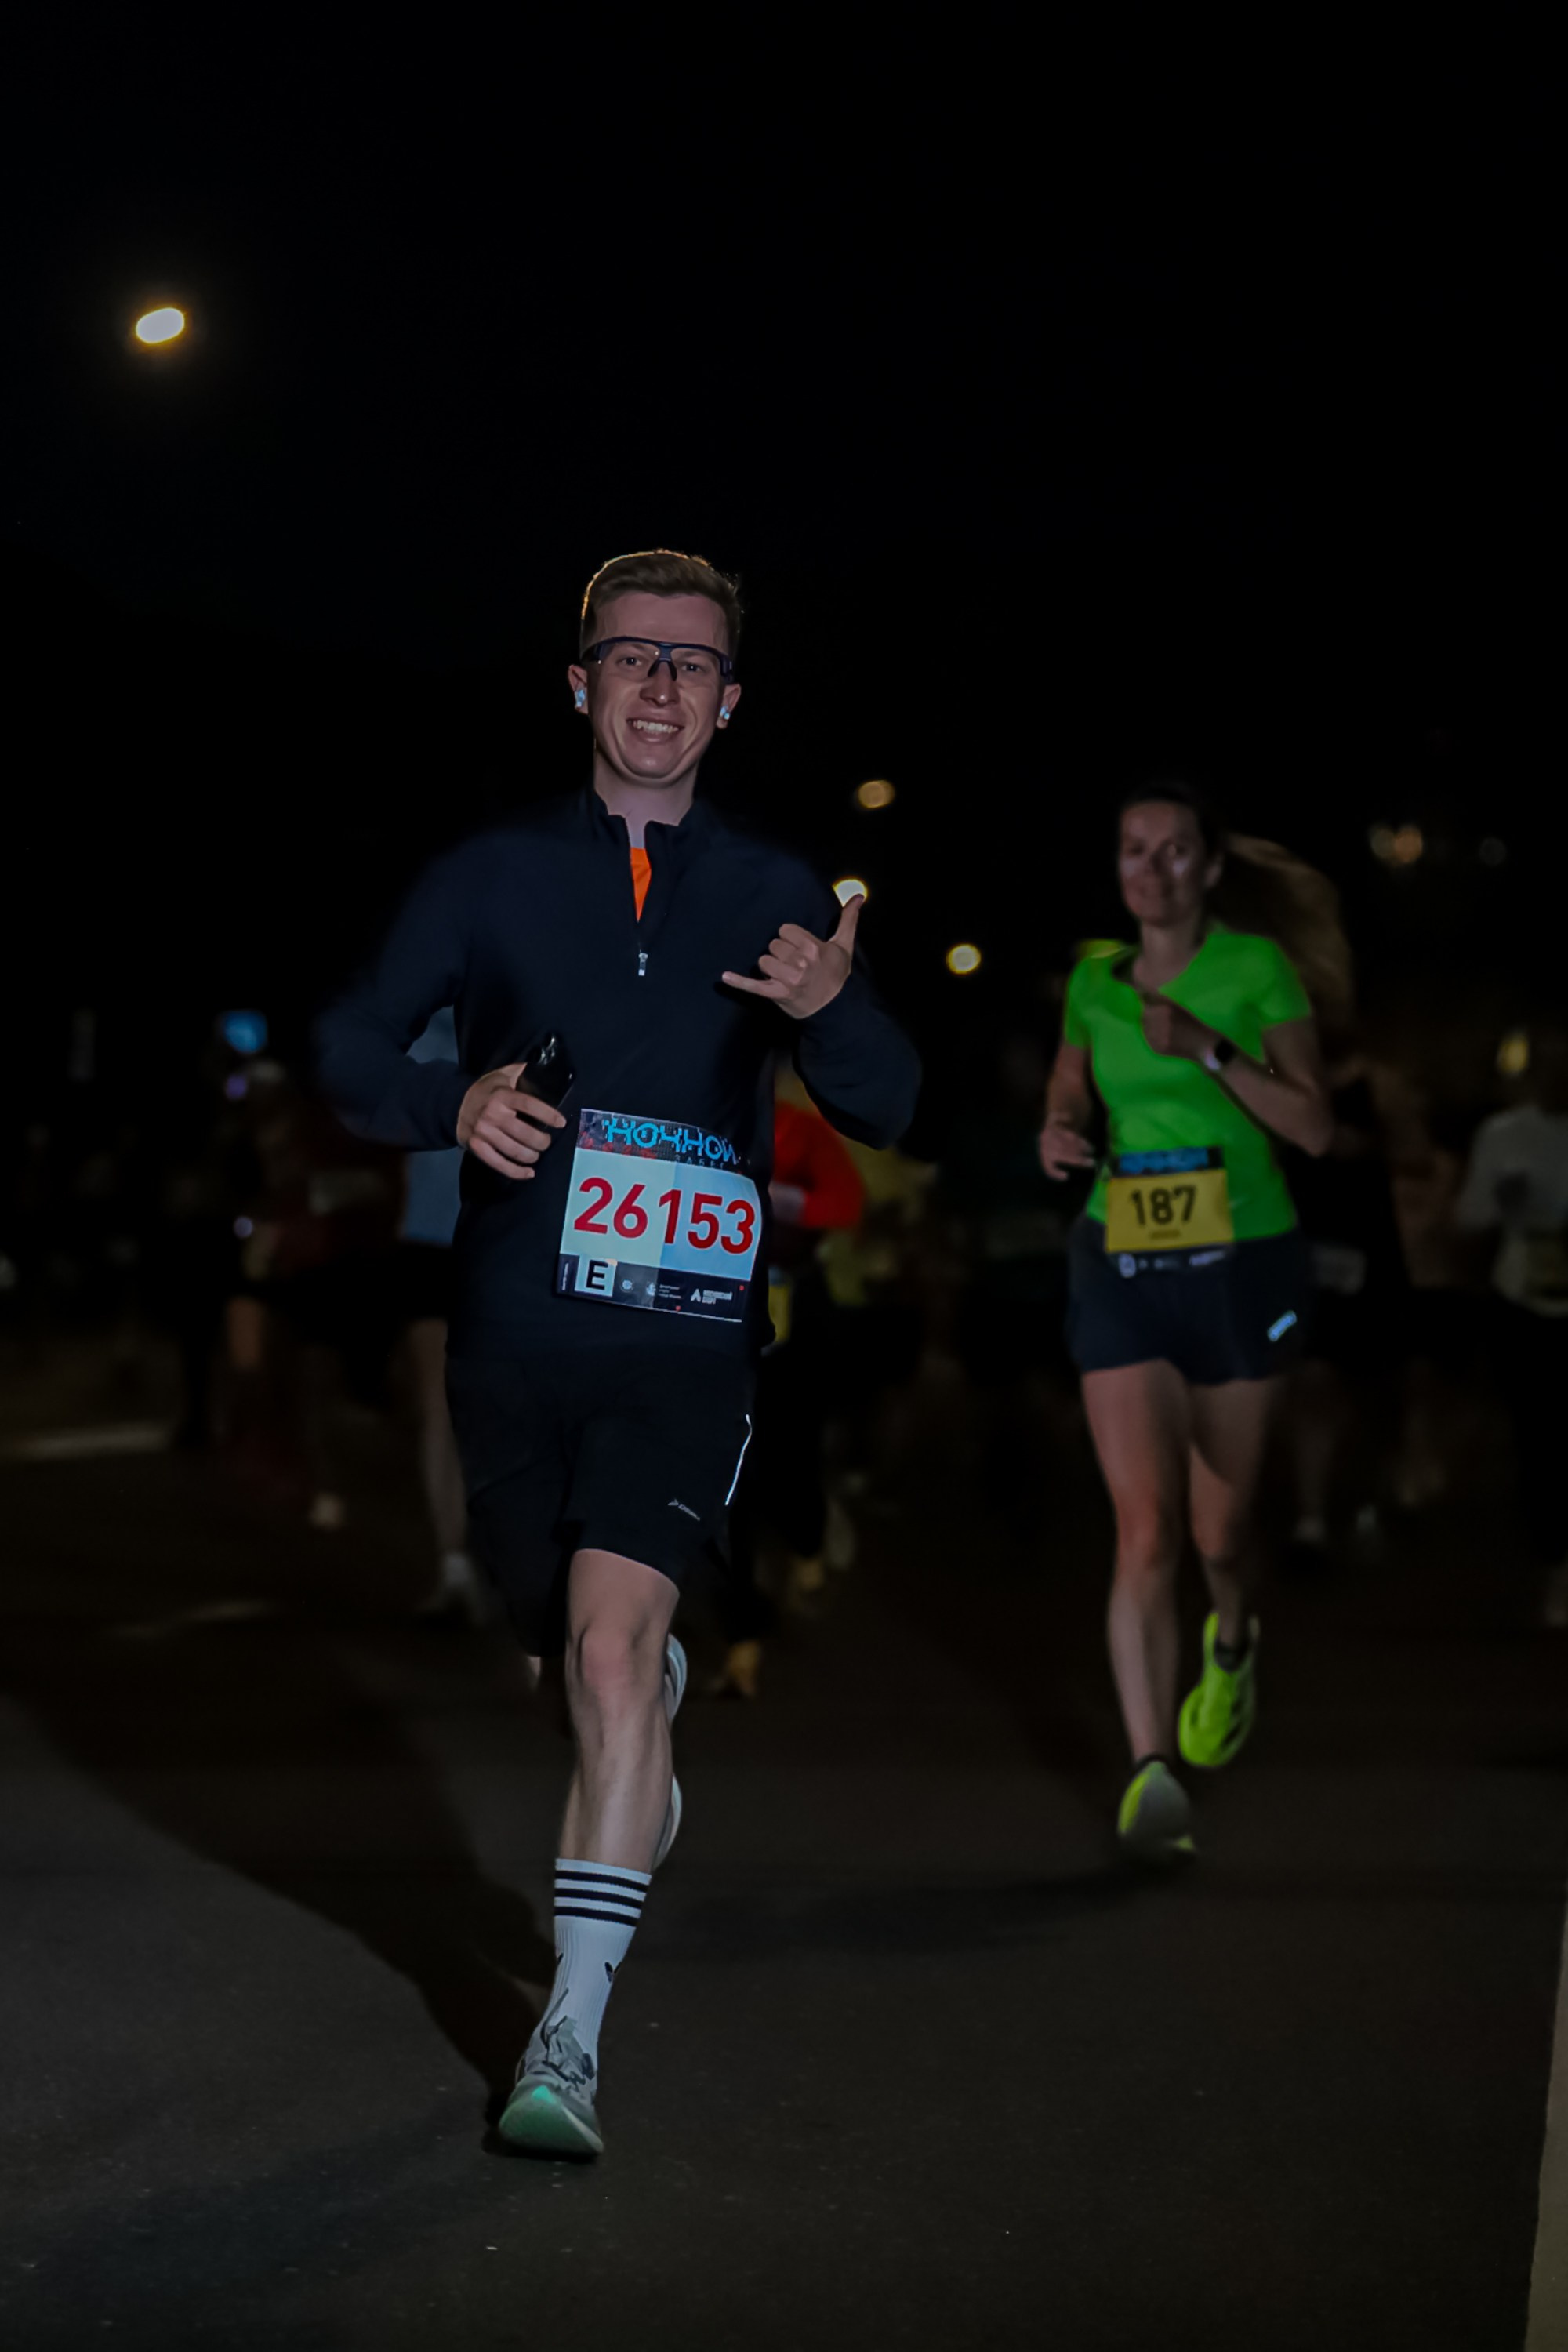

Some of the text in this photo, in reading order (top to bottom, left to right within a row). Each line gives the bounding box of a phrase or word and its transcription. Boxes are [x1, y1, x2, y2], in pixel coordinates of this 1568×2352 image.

[574, 1177, 755, 1254] 26153
[1131, 1186, 1196, 1226] 187
[586, 1260, 609, 1290] E
